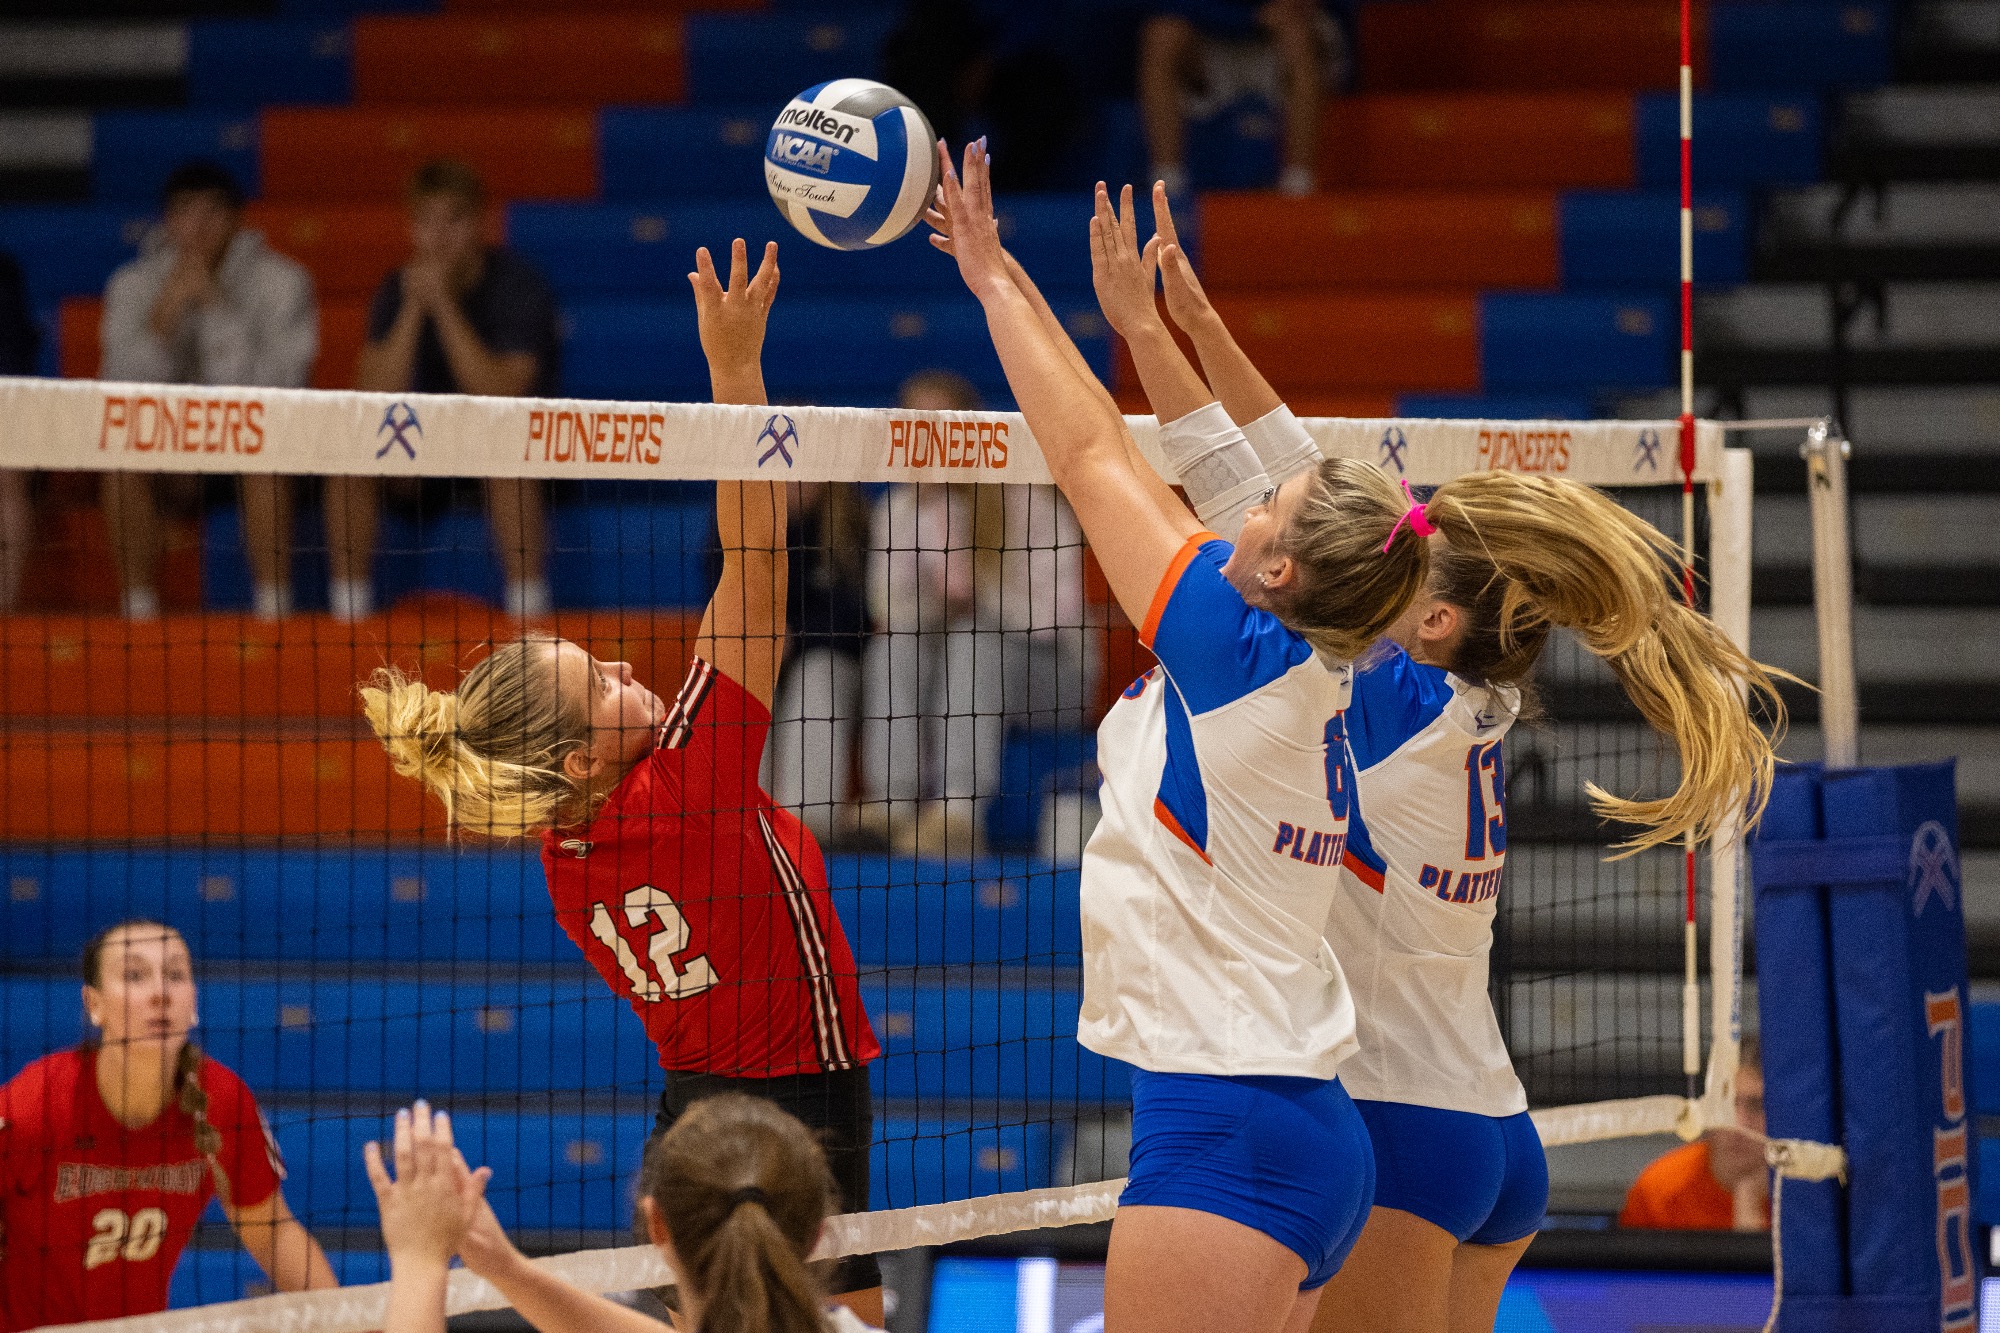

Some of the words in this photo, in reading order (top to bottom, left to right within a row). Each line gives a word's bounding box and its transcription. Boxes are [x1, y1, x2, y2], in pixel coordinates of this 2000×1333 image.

[771, 133, 834, 171] NCAA
[779, 108, 855, 144] molten
[768, 170, 792, 194] Super
[795, 183, 836, 203] Touch
[100, 396, 265, 455] PIONEERS
[525, 411, 665, 464] PIONEERS
[887, 420, 1009, 469] PIONEERS
[1475, 430, 1571, 471] PIONEERS
[1464, 738, 1506, 861] 13
[589, 884, 721, 1003] 12
[1924, 985, 1978, 1333] PIO
[84, 1207, 168, 1271] 20
